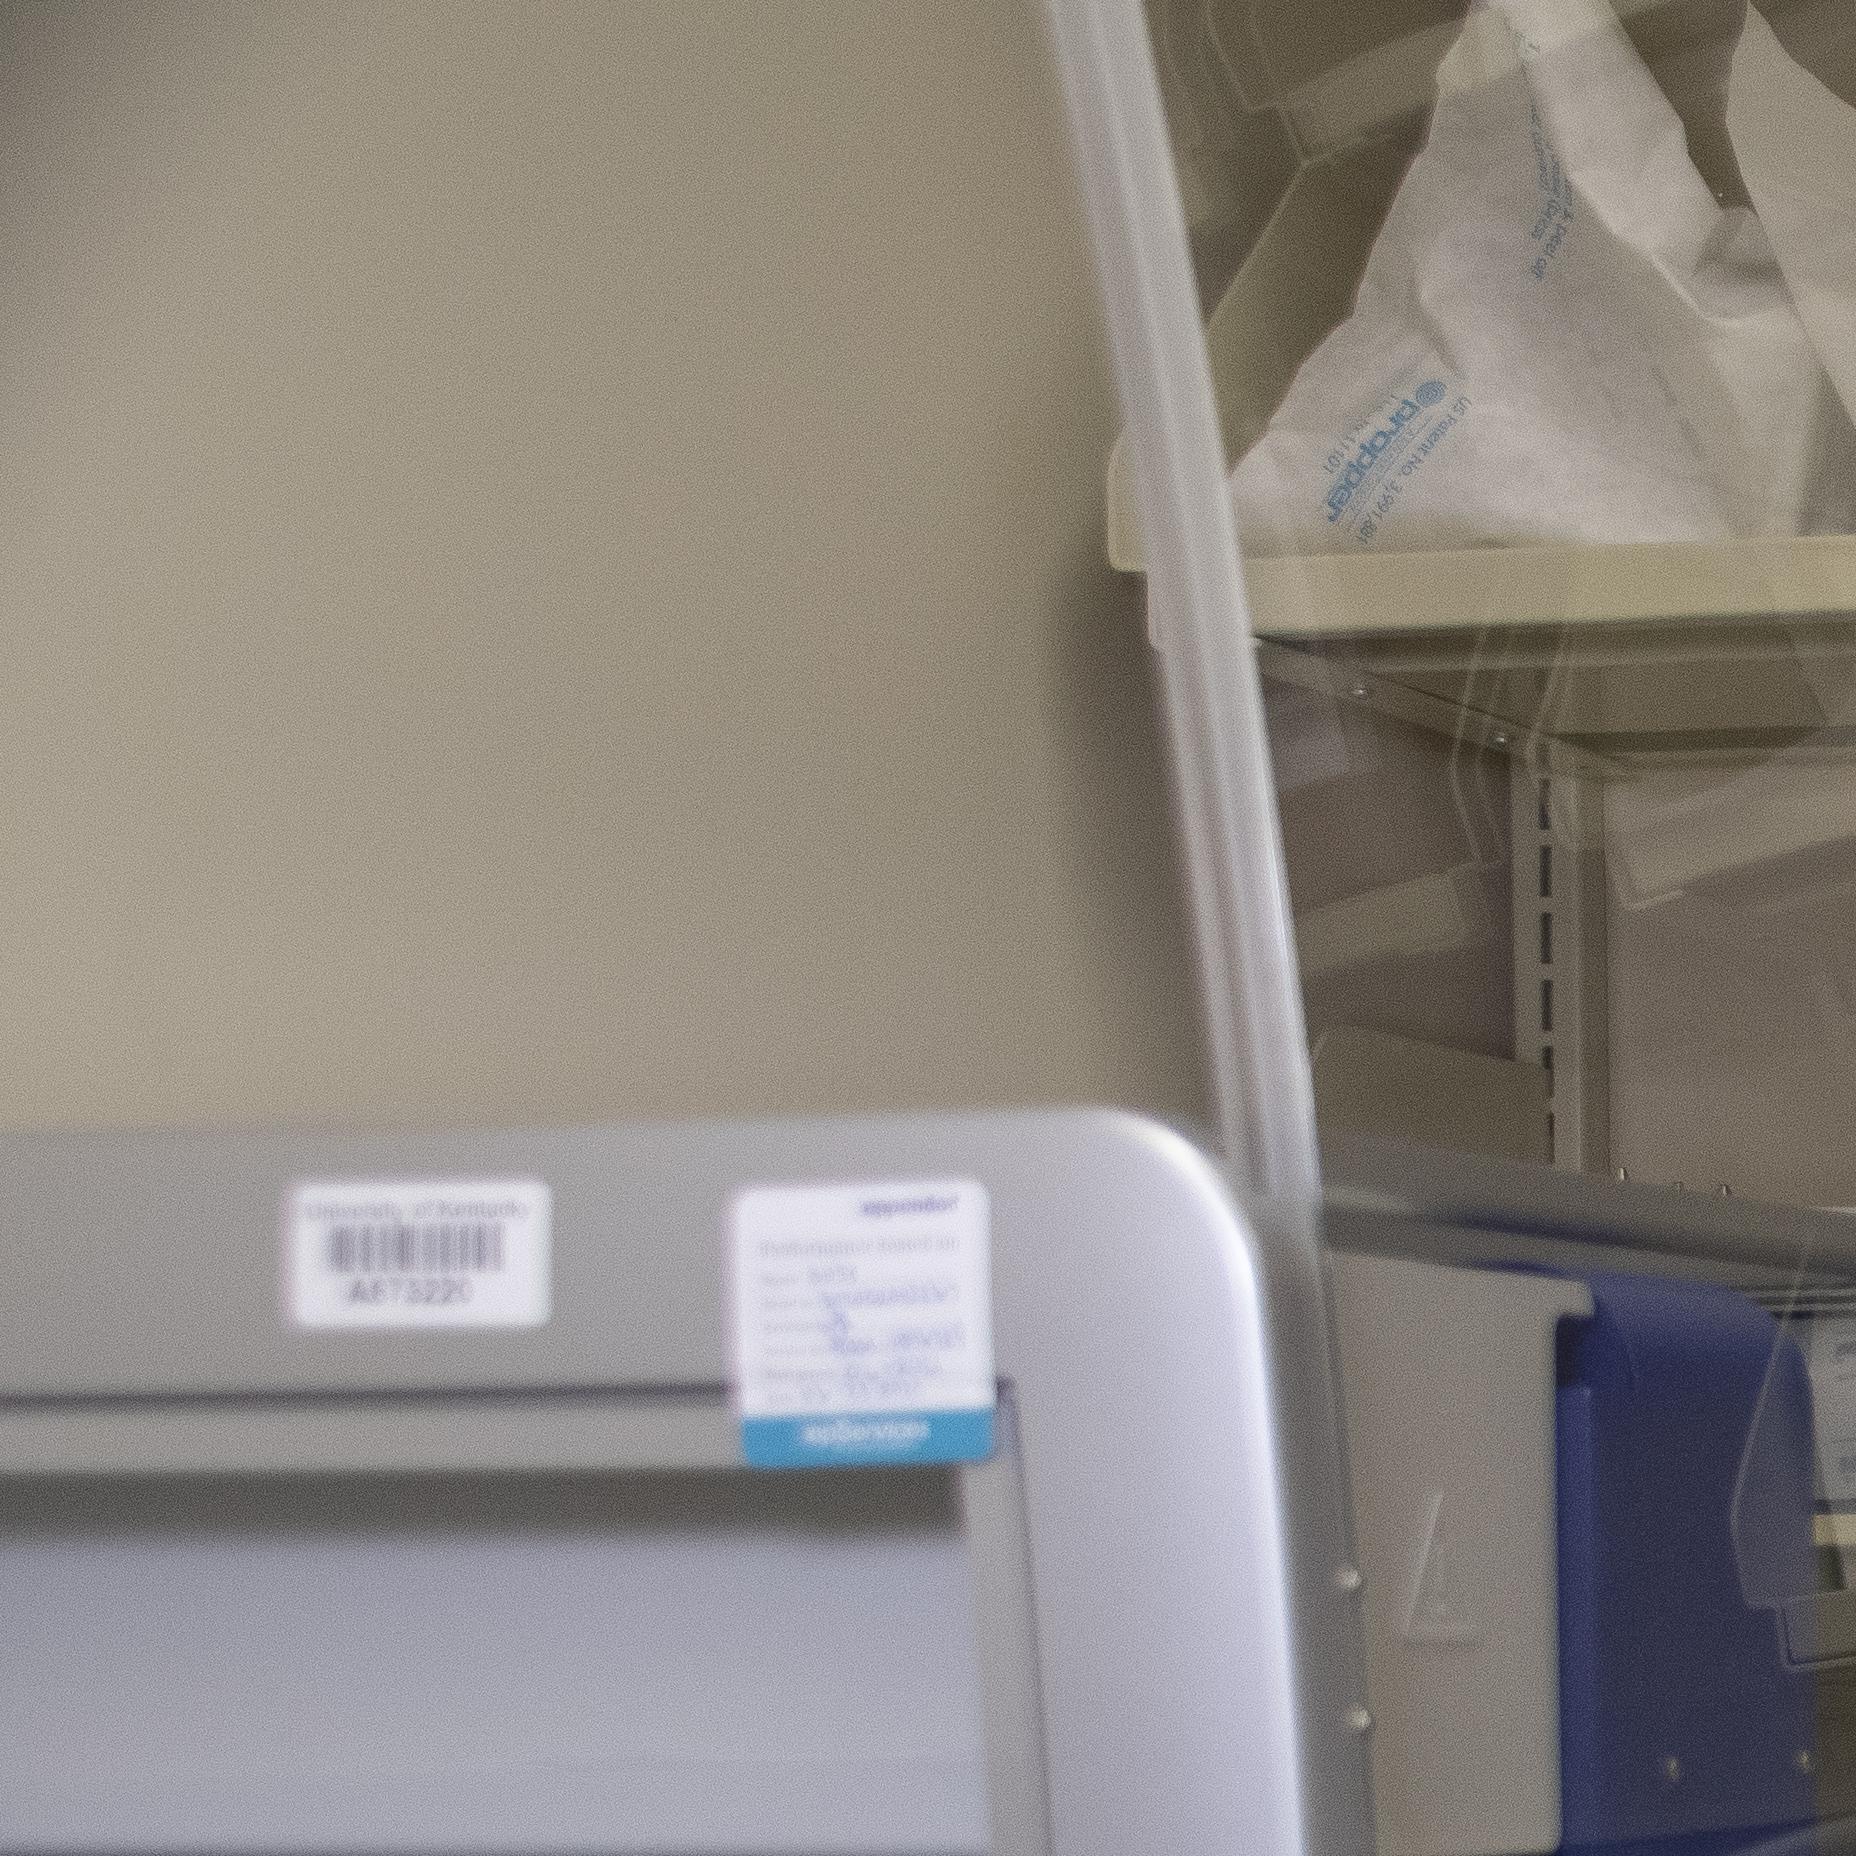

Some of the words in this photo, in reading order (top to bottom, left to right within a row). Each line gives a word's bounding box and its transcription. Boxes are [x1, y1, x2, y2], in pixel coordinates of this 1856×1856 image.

[1454, 395, 1473, 418] US
[1418, 415, 1457, 458] Patent
[1326, 397, 1423, 524] propper
